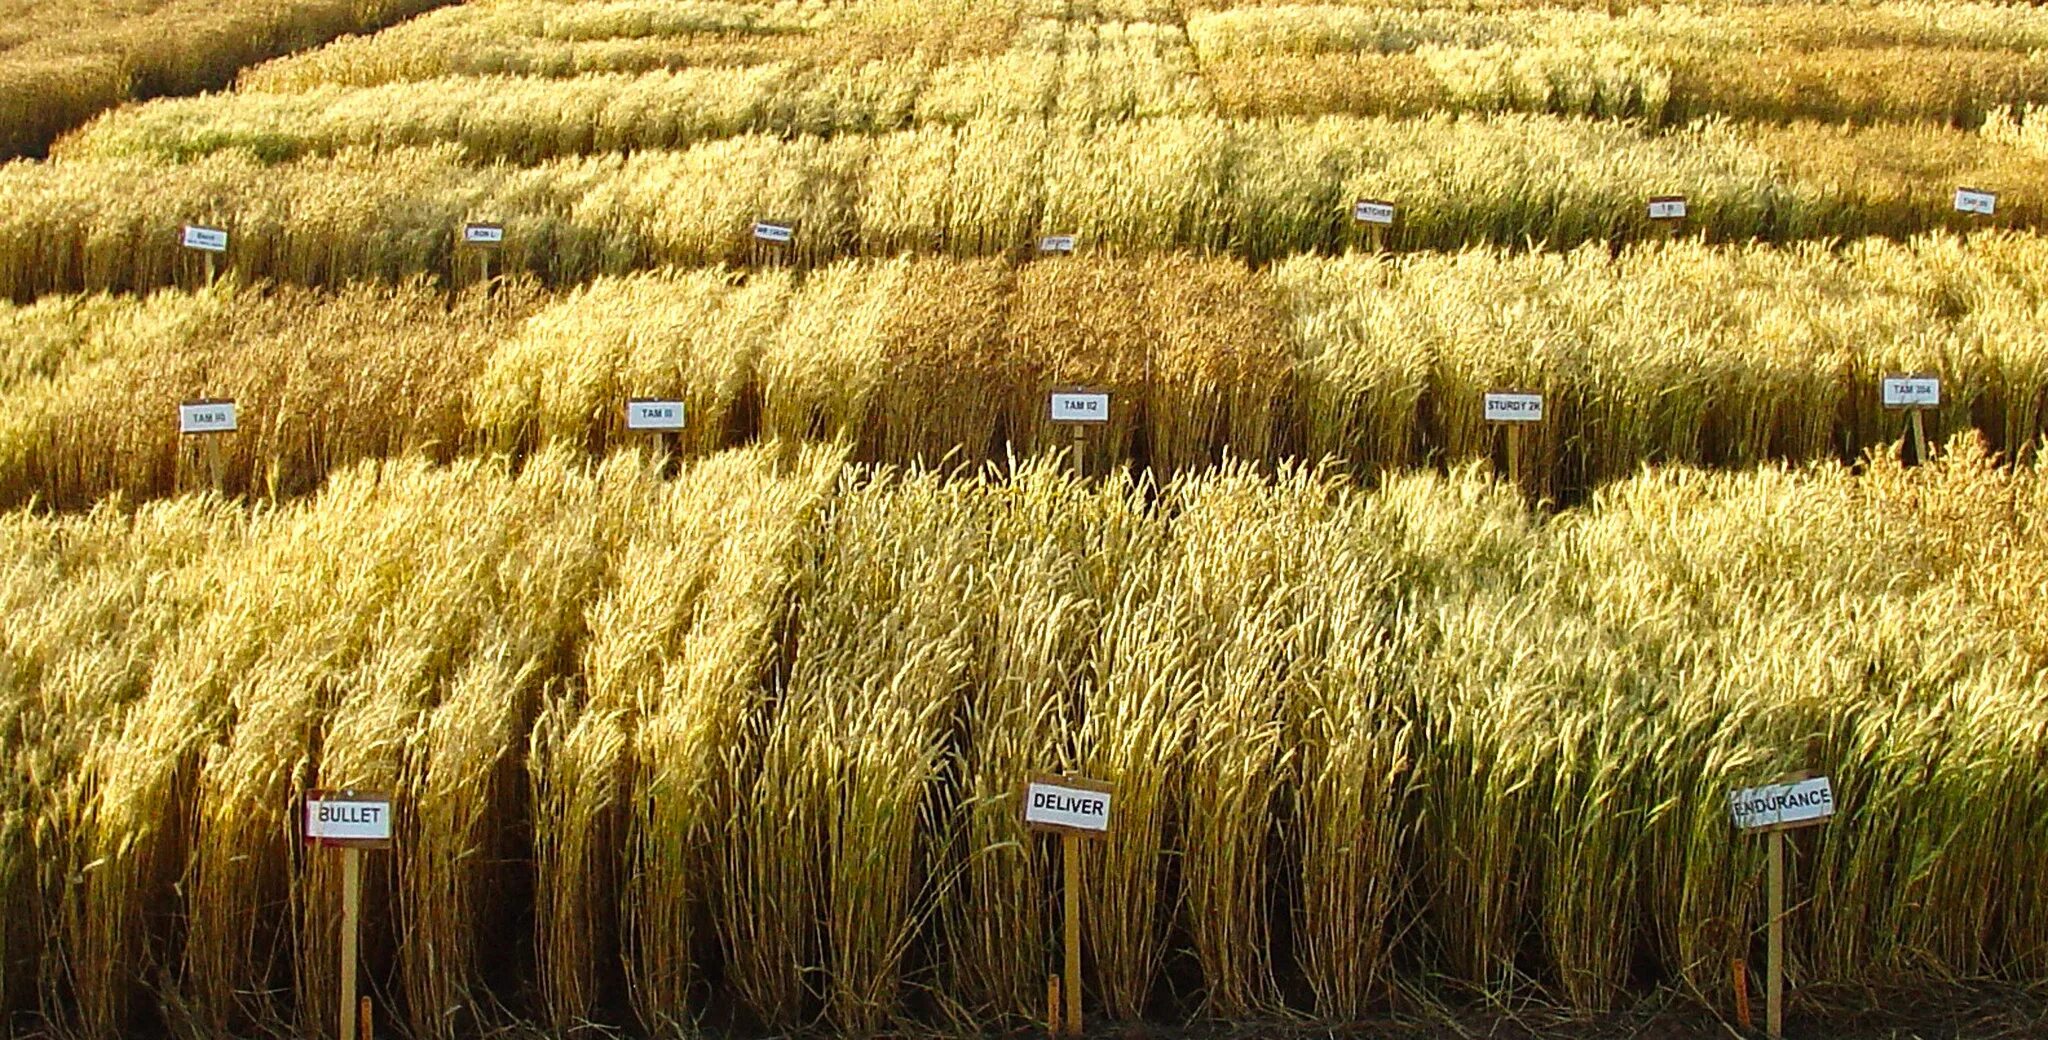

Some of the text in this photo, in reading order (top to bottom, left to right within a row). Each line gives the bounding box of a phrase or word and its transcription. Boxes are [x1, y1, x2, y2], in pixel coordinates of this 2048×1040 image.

[1893, 384, 1913, 394] TAM
[1064, 400, 1084, 410] TAM
[1488, 400, 1541, 411] STURDY 2K
[193, 413, 213, 423] TAM
[642, 408, 662, 418] TAM
[1033, 793, 1104, 816] DELIVER
[1733, 788, 1832, 817] ENDURANCE
[319, 806, 381, 823] BULLET
